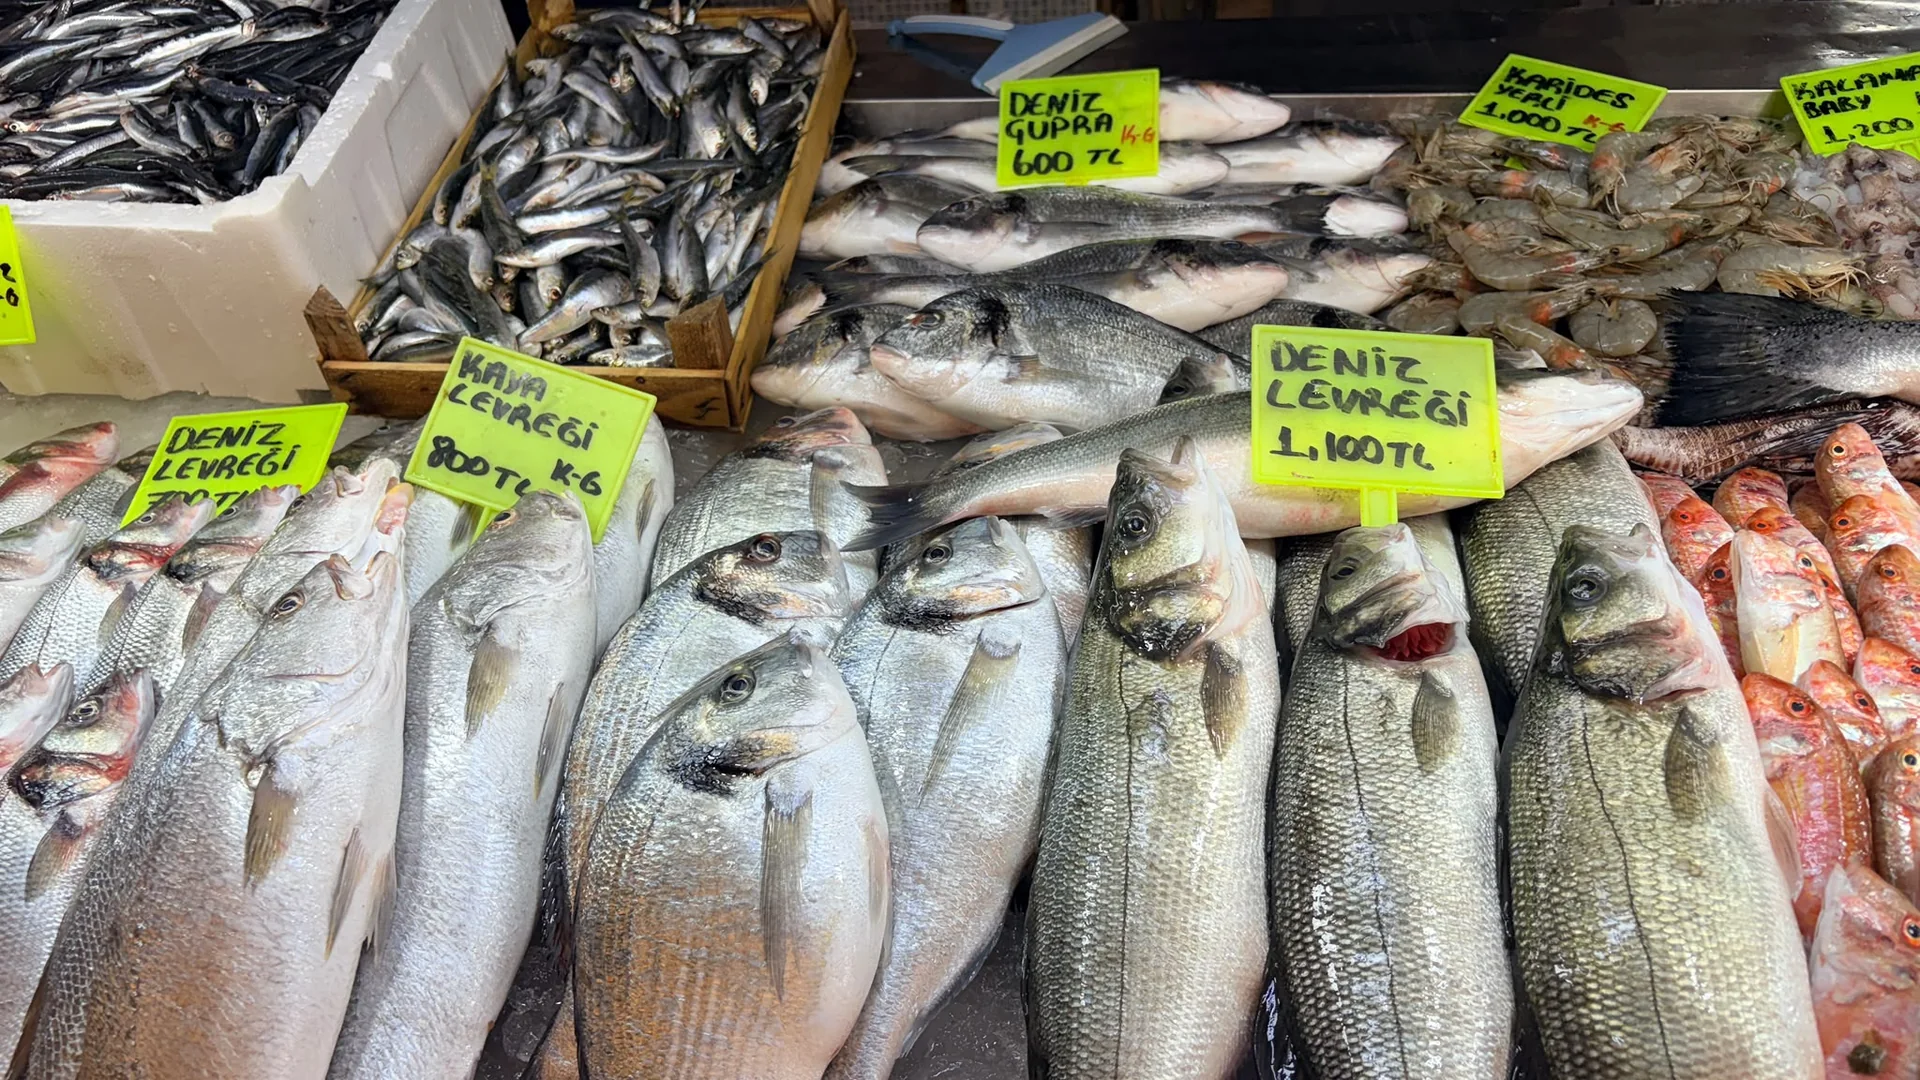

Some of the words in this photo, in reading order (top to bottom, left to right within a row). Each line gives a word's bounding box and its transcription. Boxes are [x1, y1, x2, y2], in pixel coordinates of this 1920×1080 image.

[1009, 89, 1104, 117] DENİZ
[1494, 83, 1567, 111] YERLİ
[1504, 66, 1635, 110] KARİDES
[1803, 94, 1872, 119] BABY
[1005, 113, 1114, 145] GUPRA
[1013, 149, 1074, 177] 600
[1087, 148, 1124, 165] TL
[458, 350, 548, 402] KAYA
[1270, 339, 1428, 384] DENİZ
[448, 383, 600, 451] LEVREĞİ
[1266, 378, 1472, 427] LEVREĞİ
[165, 420, 286, 454] DENİZ
[427, 435, 490, 476] 800
[152, 444, 301, 481] LEVREĞİ
